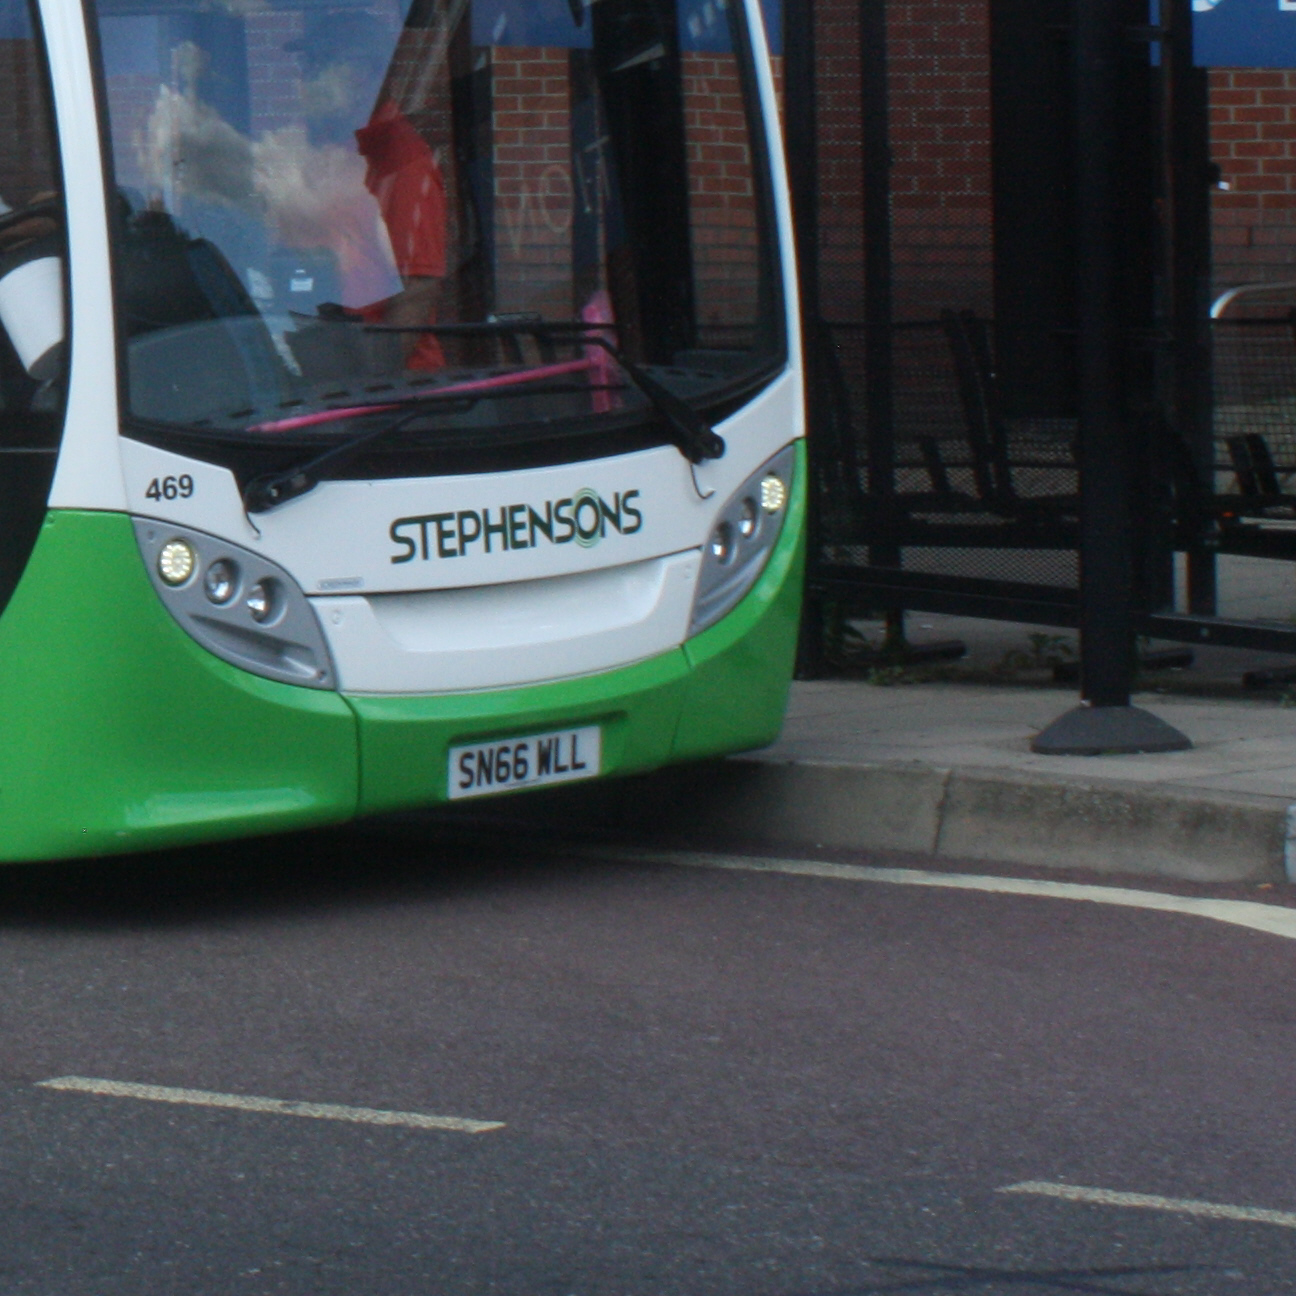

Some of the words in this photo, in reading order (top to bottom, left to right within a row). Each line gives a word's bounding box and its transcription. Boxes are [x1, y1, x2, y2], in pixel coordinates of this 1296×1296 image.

[145, 473, 194, 502] 469
[389, 488, 642, 564] STEPHENSONS
[459, 742, 529, 789] SN66
[536, 733, 586, 777] WLL
